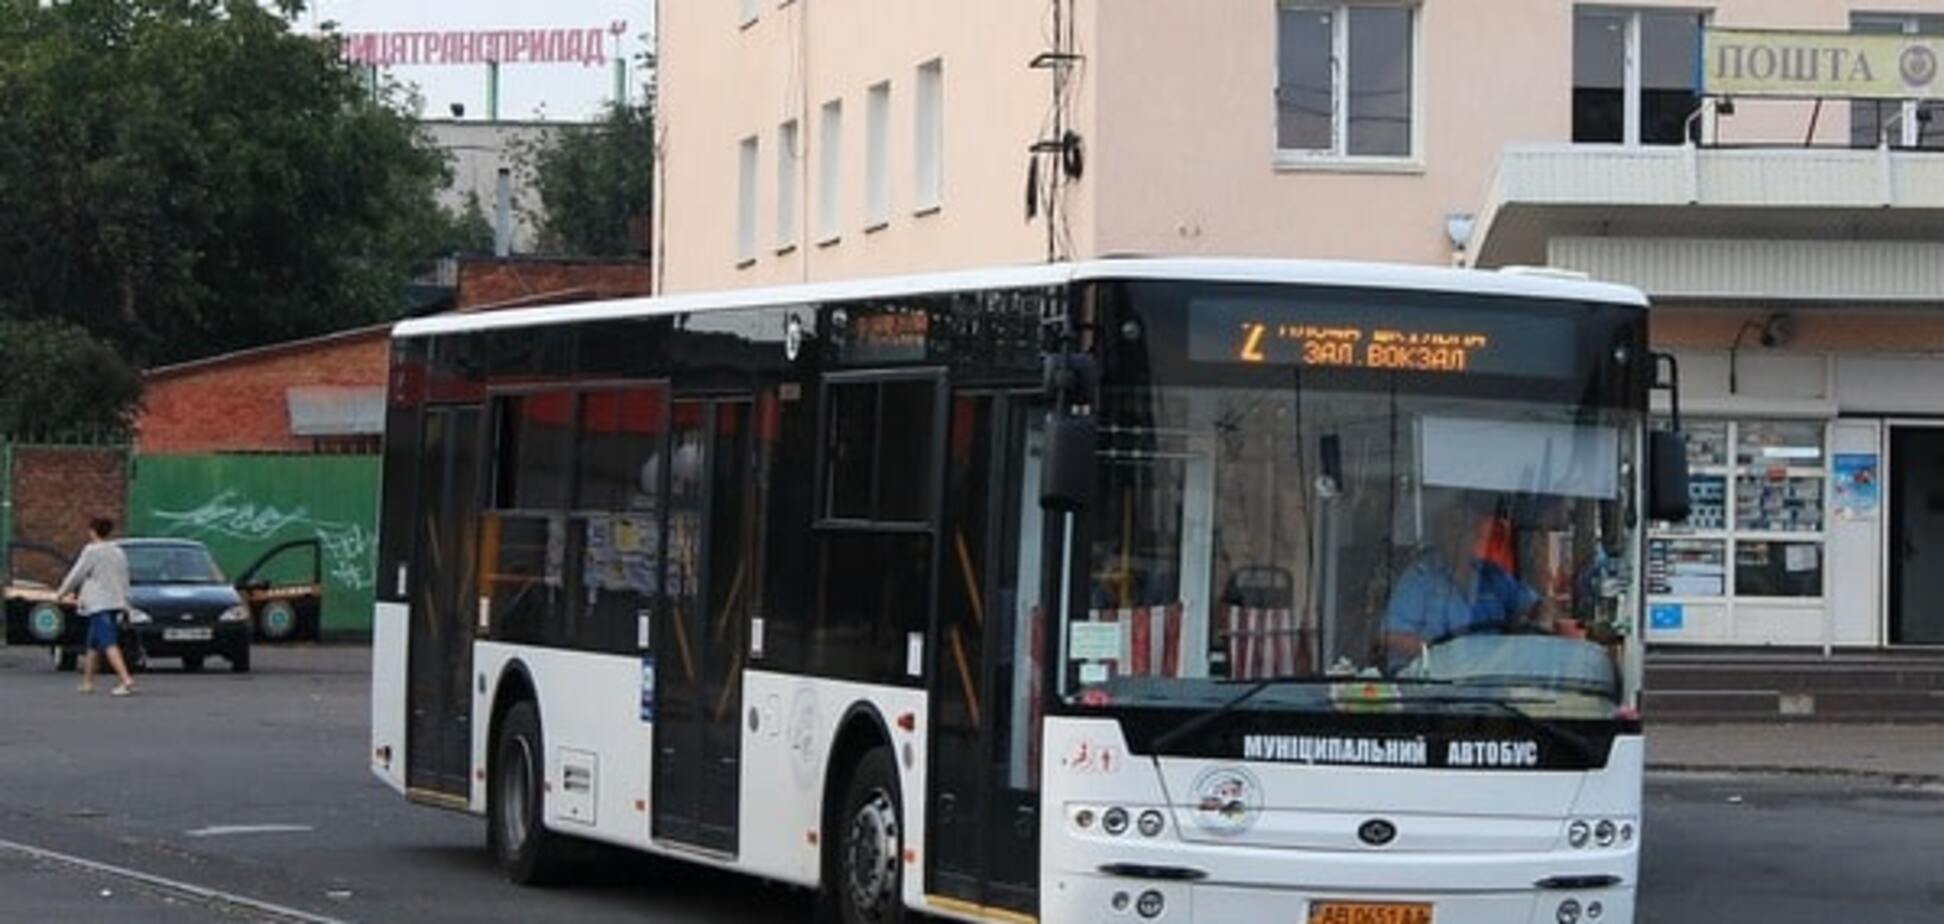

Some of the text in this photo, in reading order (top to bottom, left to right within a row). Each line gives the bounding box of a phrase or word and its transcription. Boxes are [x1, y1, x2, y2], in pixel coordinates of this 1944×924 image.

[1715, 44, 1875, 81] ПОШТА
[1243, 735, 1538, 766] МУНІЦИПАЛЬНИЙ АВТОБУС
